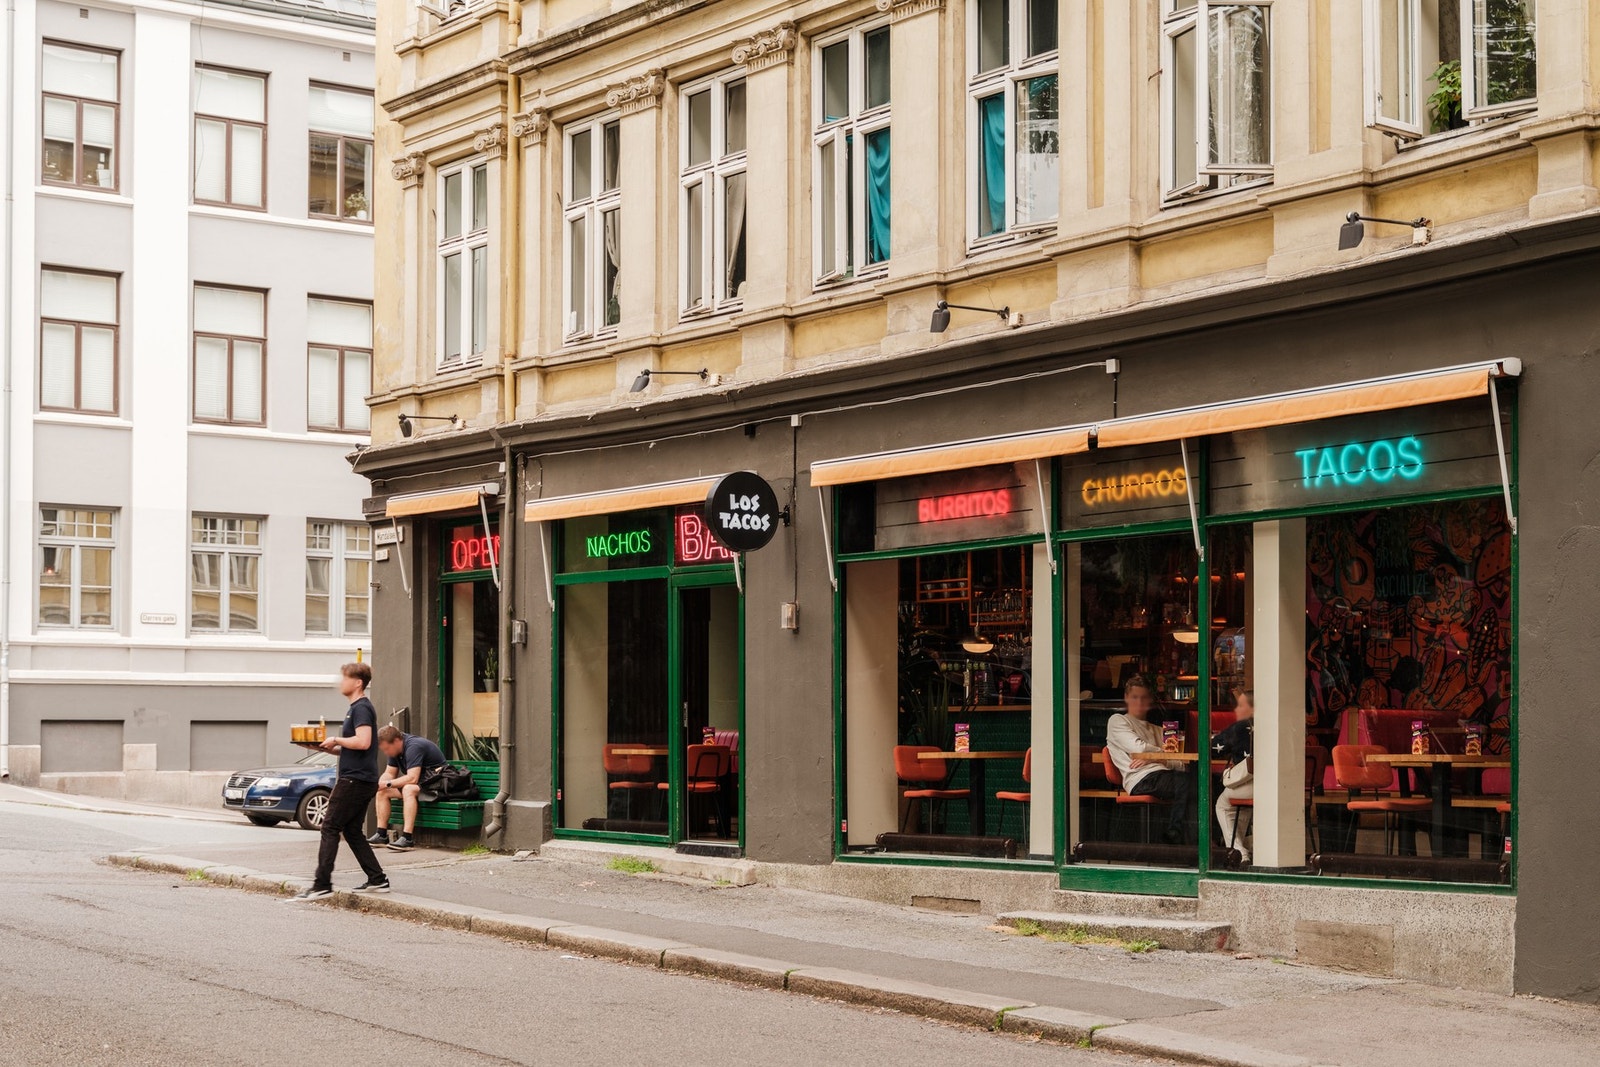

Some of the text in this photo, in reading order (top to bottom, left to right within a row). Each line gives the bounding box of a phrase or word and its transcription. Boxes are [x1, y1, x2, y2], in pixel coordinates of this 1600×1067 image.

[1295, 436, 1423, 488] TACOS
[1081, 467, 1187, 505] CHURROS
[729, 493, 760, 513] LOS
[918, 489, 1010, 523] BURRITOS
[719, 512, 771, 532] TACOS
[586, 530, 651, 558] NACHOS
[680, 514, 741, 562] BA
[1375, 573, 1431, 598] SOCIALIZE
